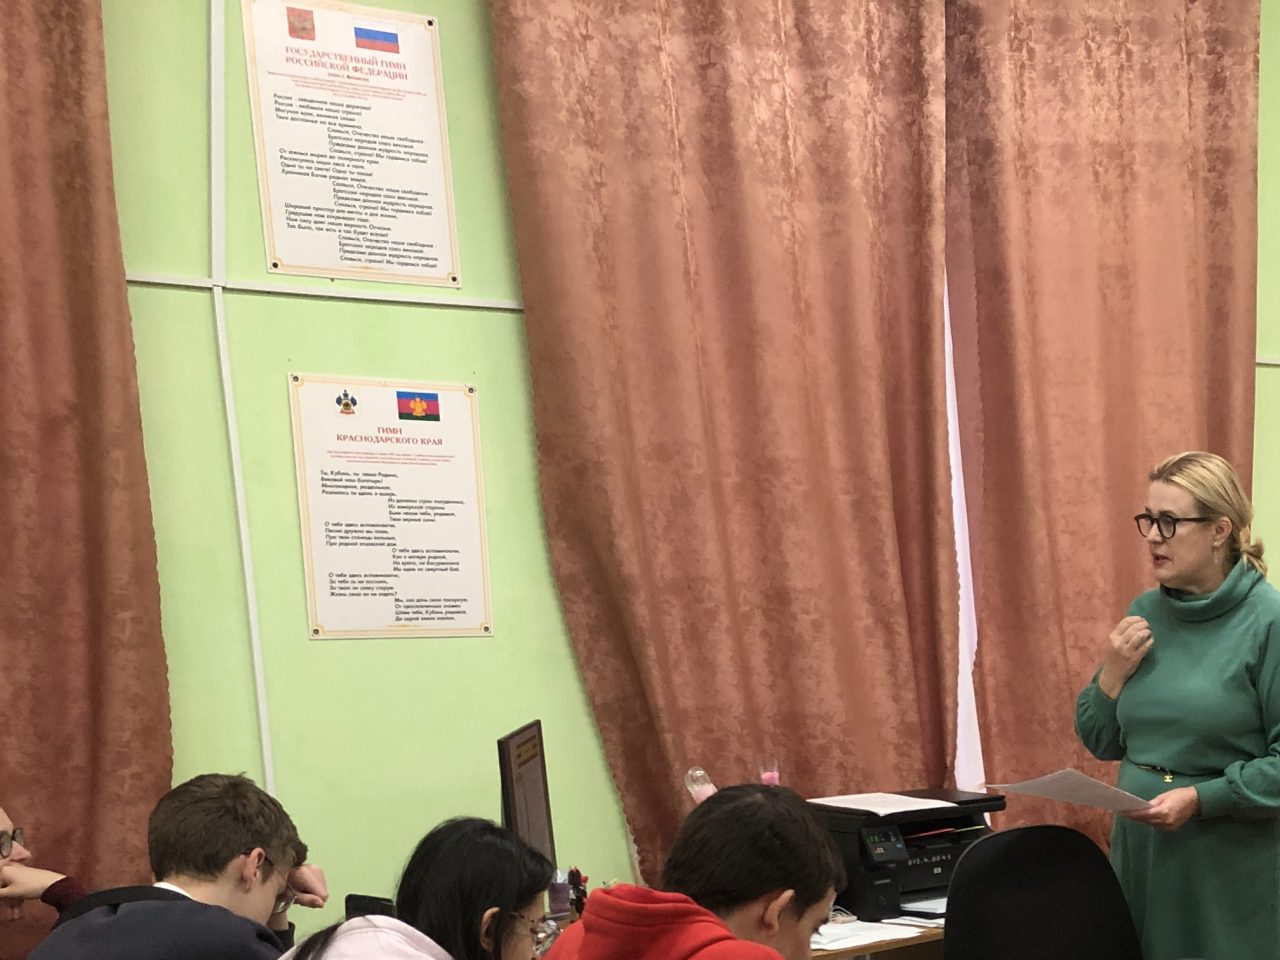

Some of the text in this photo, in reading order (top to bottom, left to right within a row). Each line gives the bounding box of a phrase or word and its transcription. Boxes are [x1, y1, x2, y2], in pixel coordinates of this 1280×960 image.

[285, 46, 406, 71] ГОСУДАРСТВЕННЫЙ ГИМН
[285, 56, 349, 70] РОССИЙСКОЙ
[352, 66, 408, 80] ФЕДЕРАЦИИ
[377, 426, 402, 435] ГИМН
[336, 434, 443, 446] КРАСНОДАРСКОГО КРАЯ
